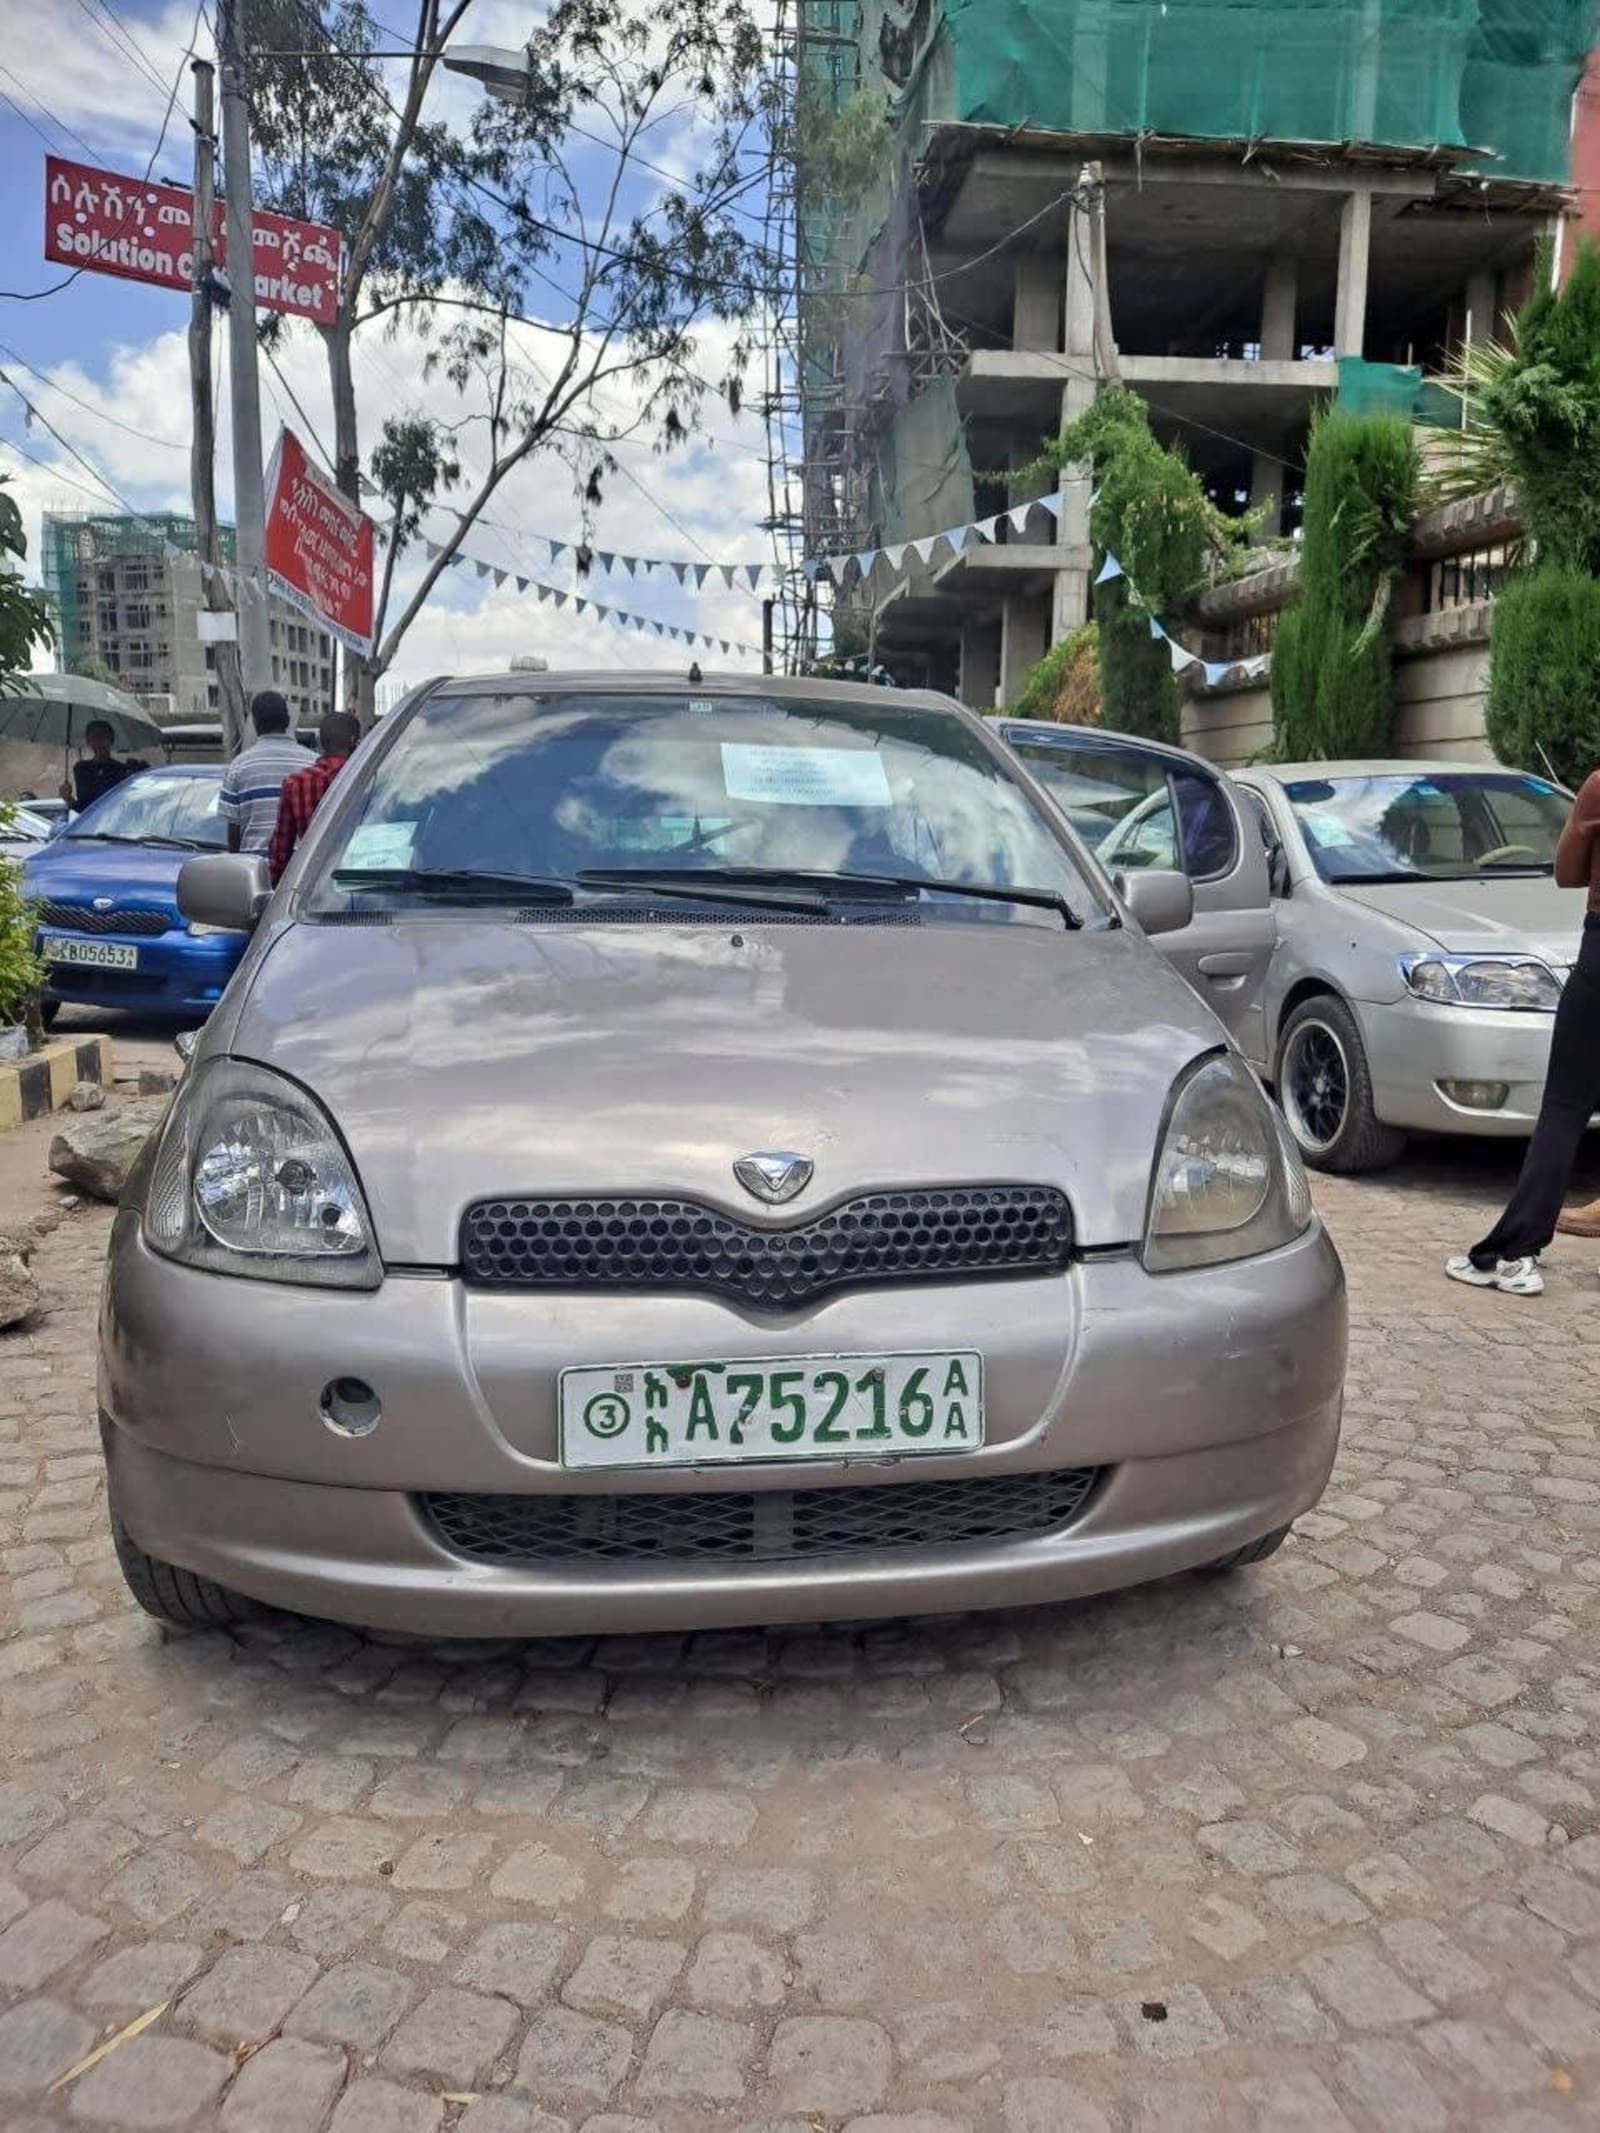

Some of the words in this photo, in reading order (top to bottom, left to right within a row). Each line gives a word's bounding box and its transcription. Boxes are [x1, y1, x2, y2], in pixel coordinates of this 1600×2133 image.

[56, 222, 174, 276] Solution
[254, 274, 323, 310] arket
[685, 1367, 934, 1445] A75216
